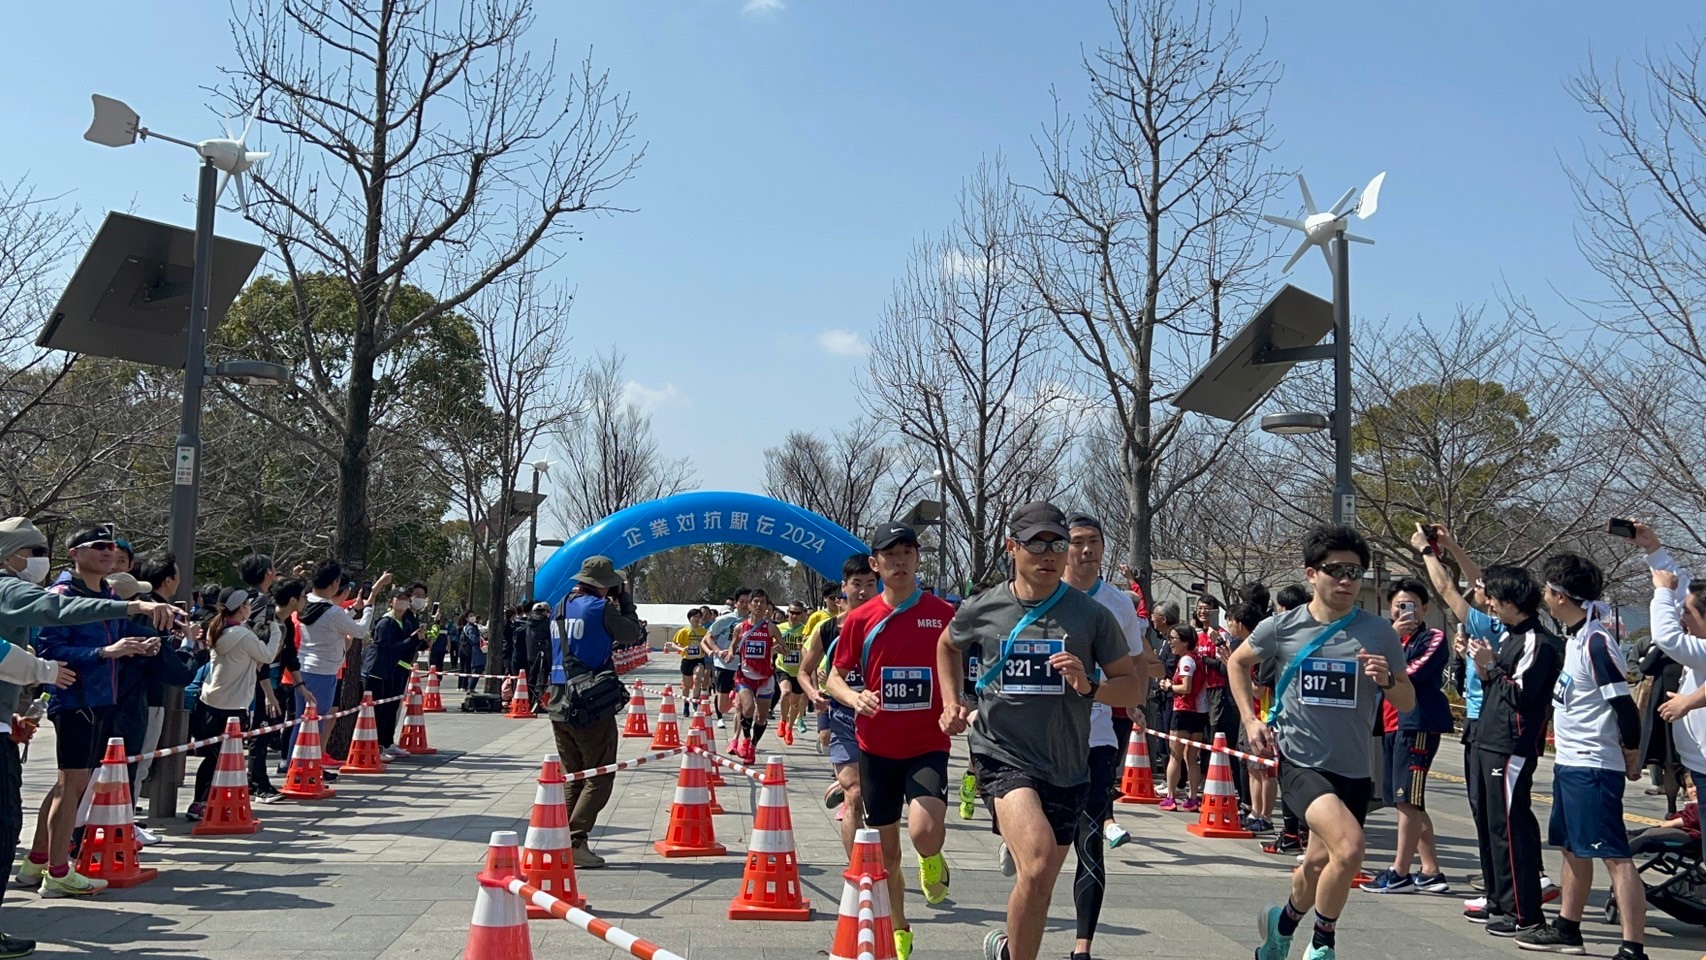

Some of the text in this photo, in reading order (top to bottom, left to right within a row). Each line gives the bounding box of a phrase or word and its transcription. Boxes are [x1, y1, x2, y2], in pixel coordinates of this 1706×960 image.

[622, 511, 826, 554] 企業対抗駅伝 2024
[917, 619, 942, 628] MRES
